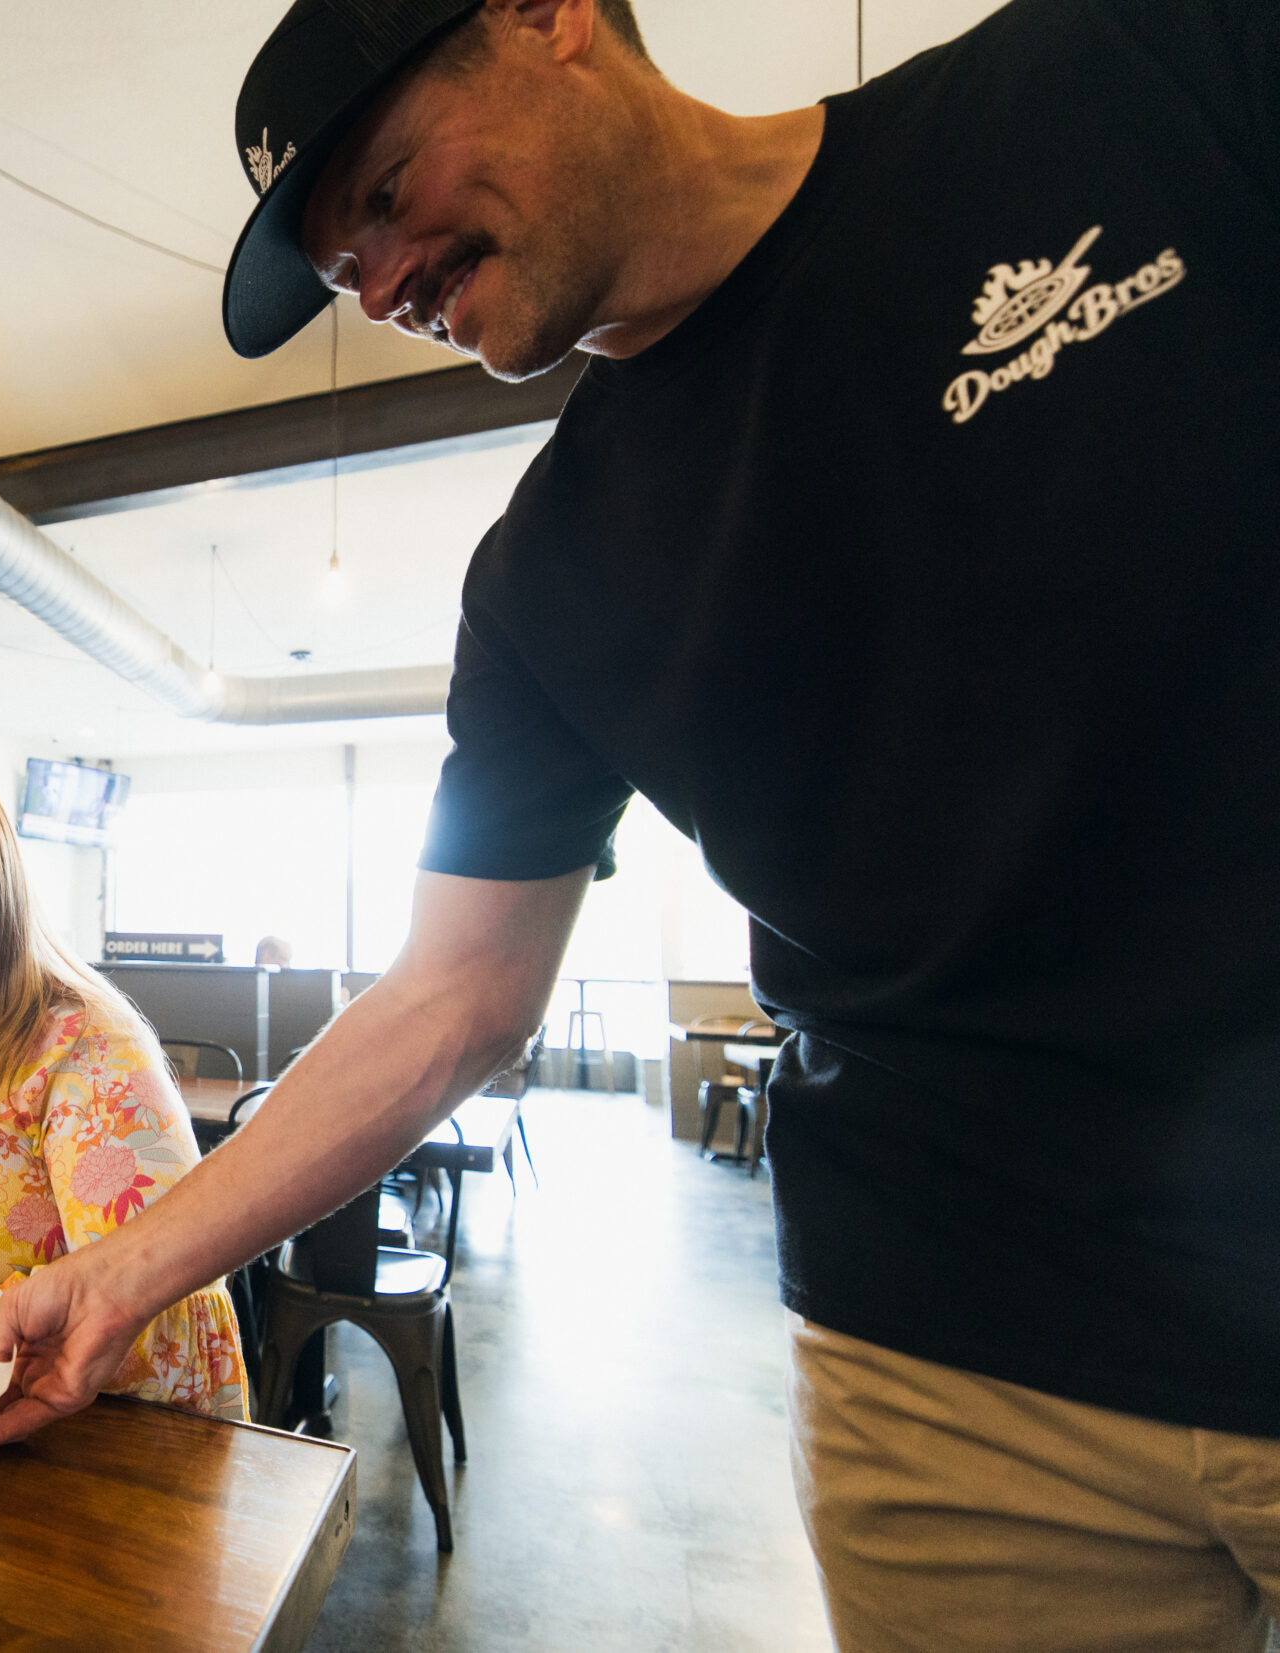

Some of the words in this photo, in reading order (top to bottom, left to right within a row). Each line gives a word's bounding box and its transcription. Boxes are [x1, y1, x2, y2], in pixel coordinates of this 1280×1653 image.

[941, 320, 1077, 424] Dough
[1067, 247, 1186, 342] Bros
[106, 940, 149, 954] ORDER
[150, 941, 184, 955] HERE
